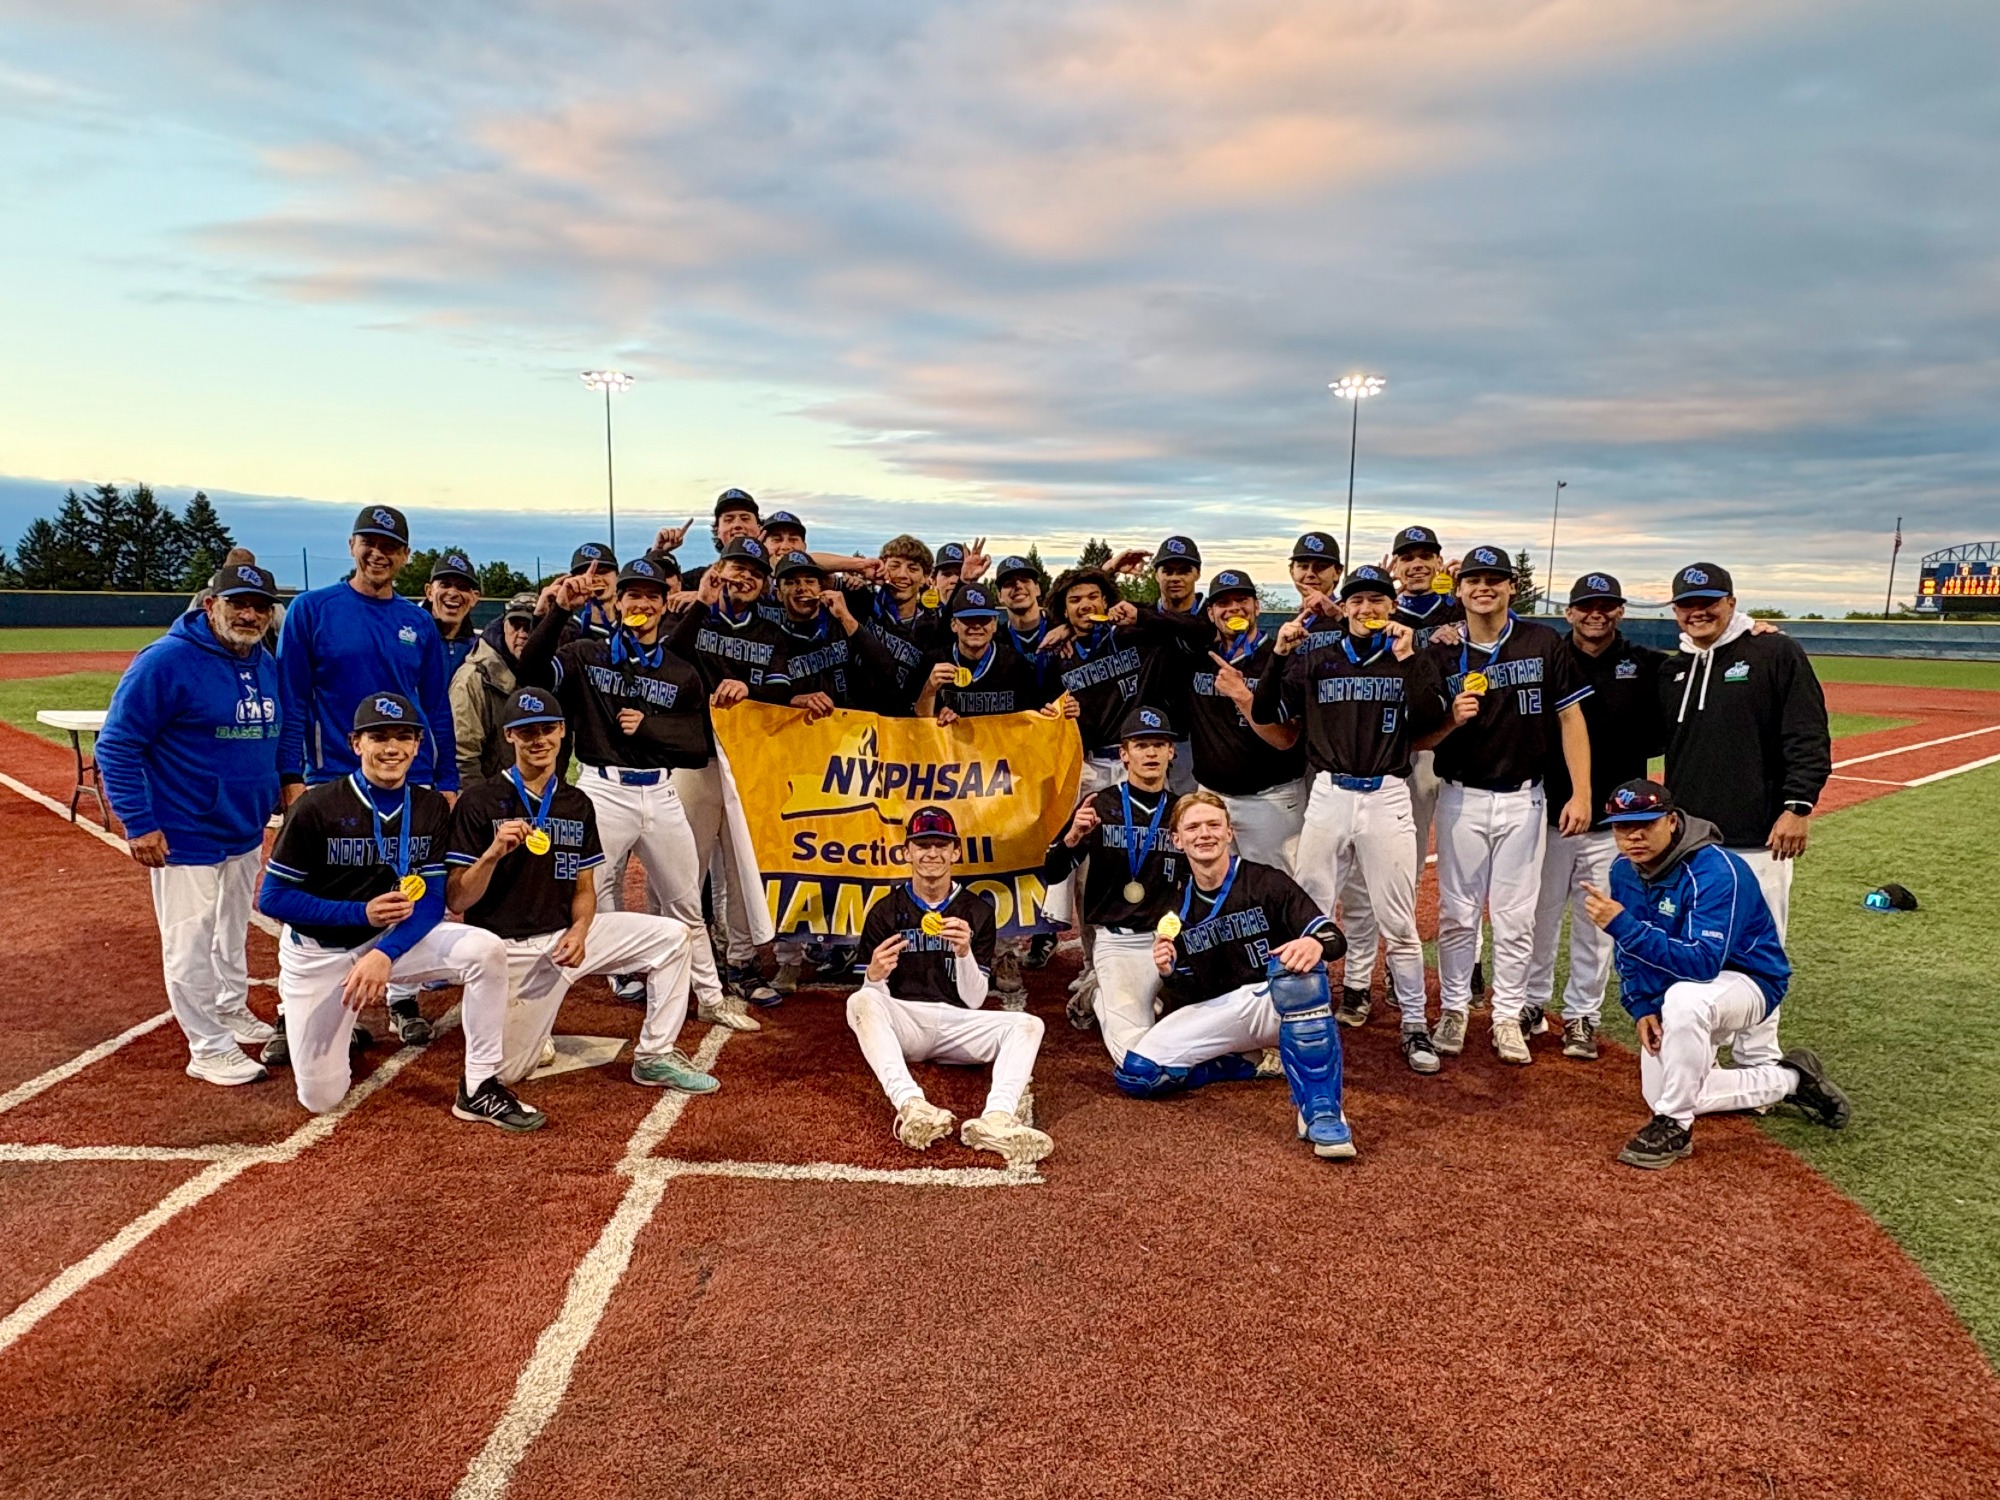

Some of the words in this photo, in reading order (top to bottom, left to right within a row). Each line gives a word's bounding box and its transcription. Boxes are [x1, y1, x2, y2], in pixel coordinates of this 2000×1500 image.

[695, 628, 775, 666] ORTHSTARS
[1318, 678, 1404, 703] NORTHSTAR
[1517, 688, 1542, 715] 12
[1382, 708, 1397, 733] 9
[791, 831, 910, 866] Sectio
[955, 836, 994, 865] II
[555, 852, 580, 880] 23
[1163, 857, 1176, 882] 4
